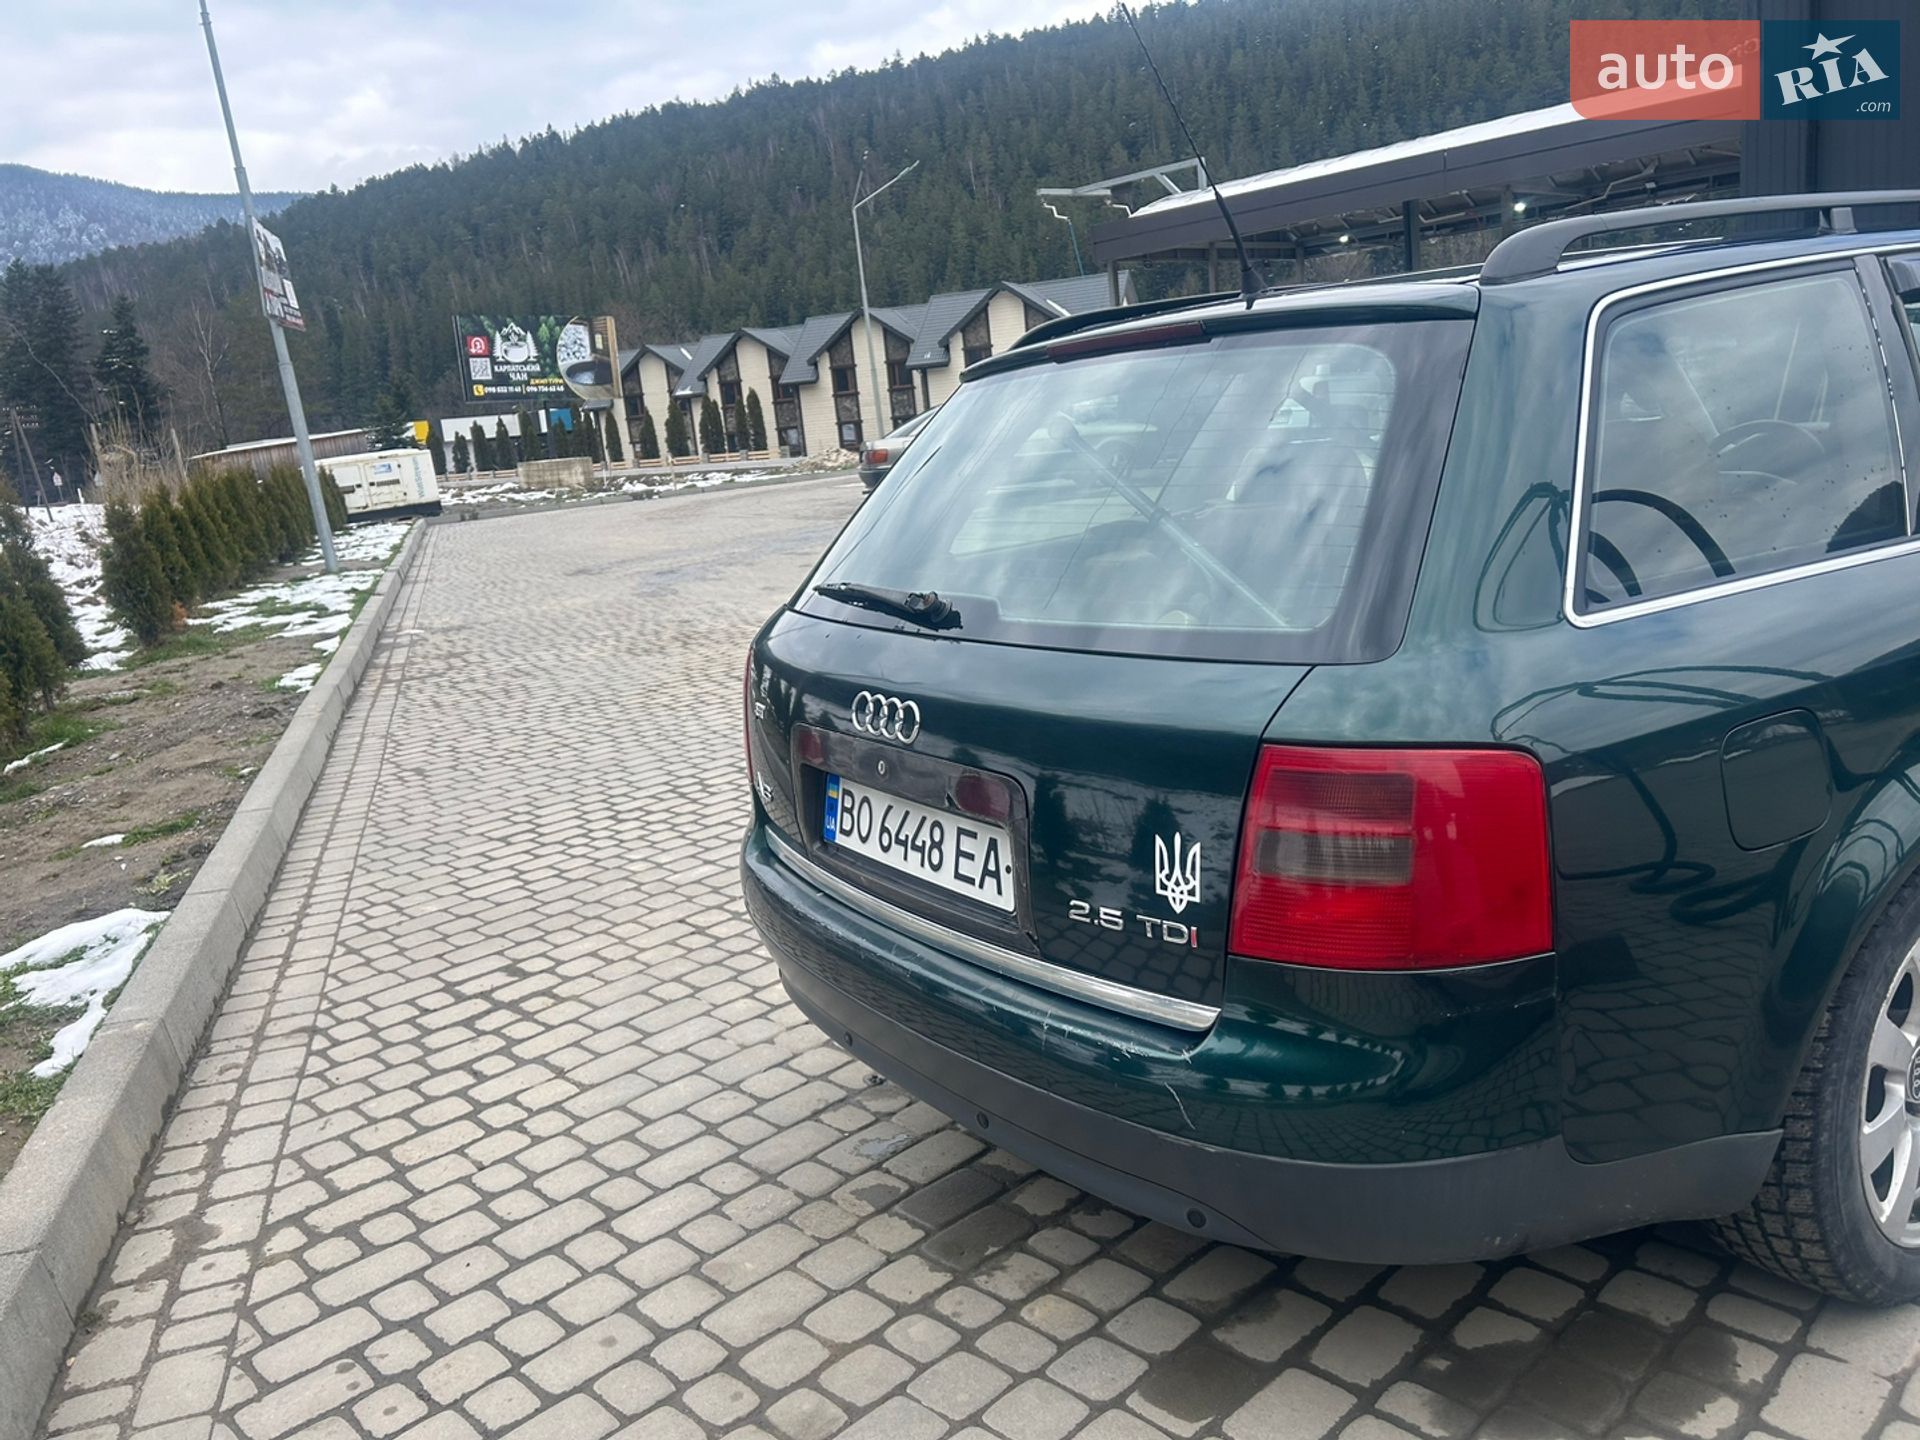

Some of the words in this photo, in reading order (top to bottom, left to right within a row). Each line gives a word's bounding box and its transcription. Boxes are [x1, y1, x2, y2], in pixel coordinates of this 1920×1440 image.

[509, 372, 528, 381] ЧАН
[838, 787, 874, 845] BO
[878, 805, 945, 873] 6448
[953, 826, 1002, 896] EA
[1068, 899, 1125, 931] 2.5
[1136, 914, 1197, 949] TDI
